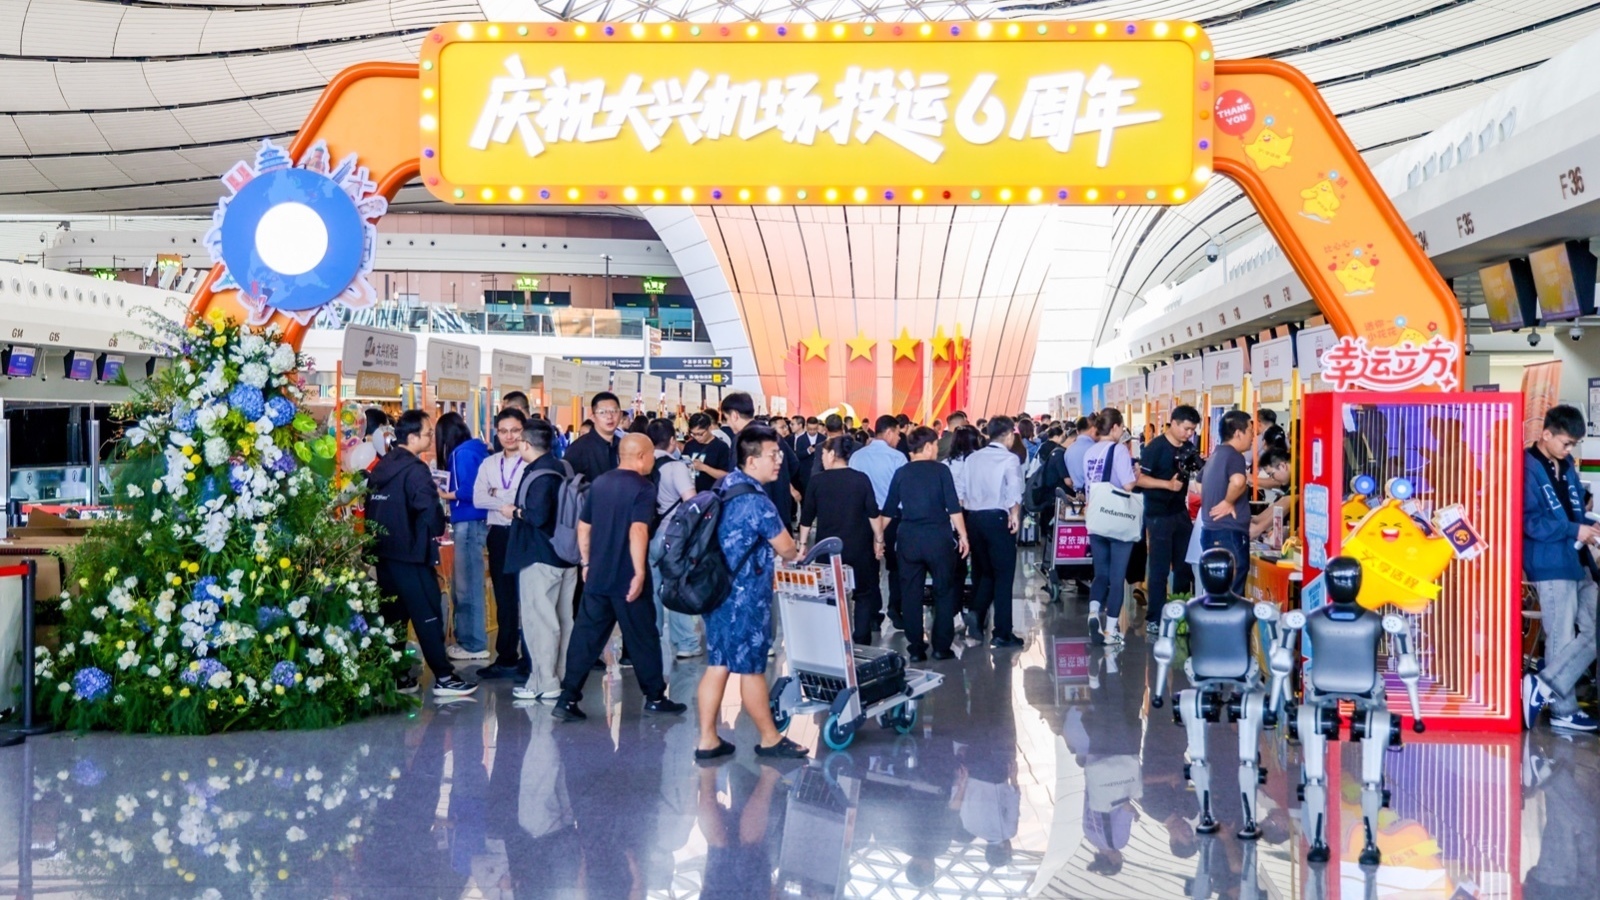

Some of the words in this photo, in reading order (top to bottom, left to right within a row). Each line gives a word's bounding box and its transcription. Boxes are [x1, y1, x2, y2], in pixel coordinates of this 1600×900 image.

[469, 54, 1161, 167] 庆祝大兴机场投运6周年
[1217, 102, 1251, 118] THANK
[1226, 113, 1247, 125] YOU
[1559, 166, 1585, 199] F36
[1456, 212, 1475, 238] F35
[12, 328, 23, 338] G14
[49, 332, 60, 342] G15
[1324, 339, 1453, 390] 幸运立方
[1100, 506, 1137, 520] Redammcy
